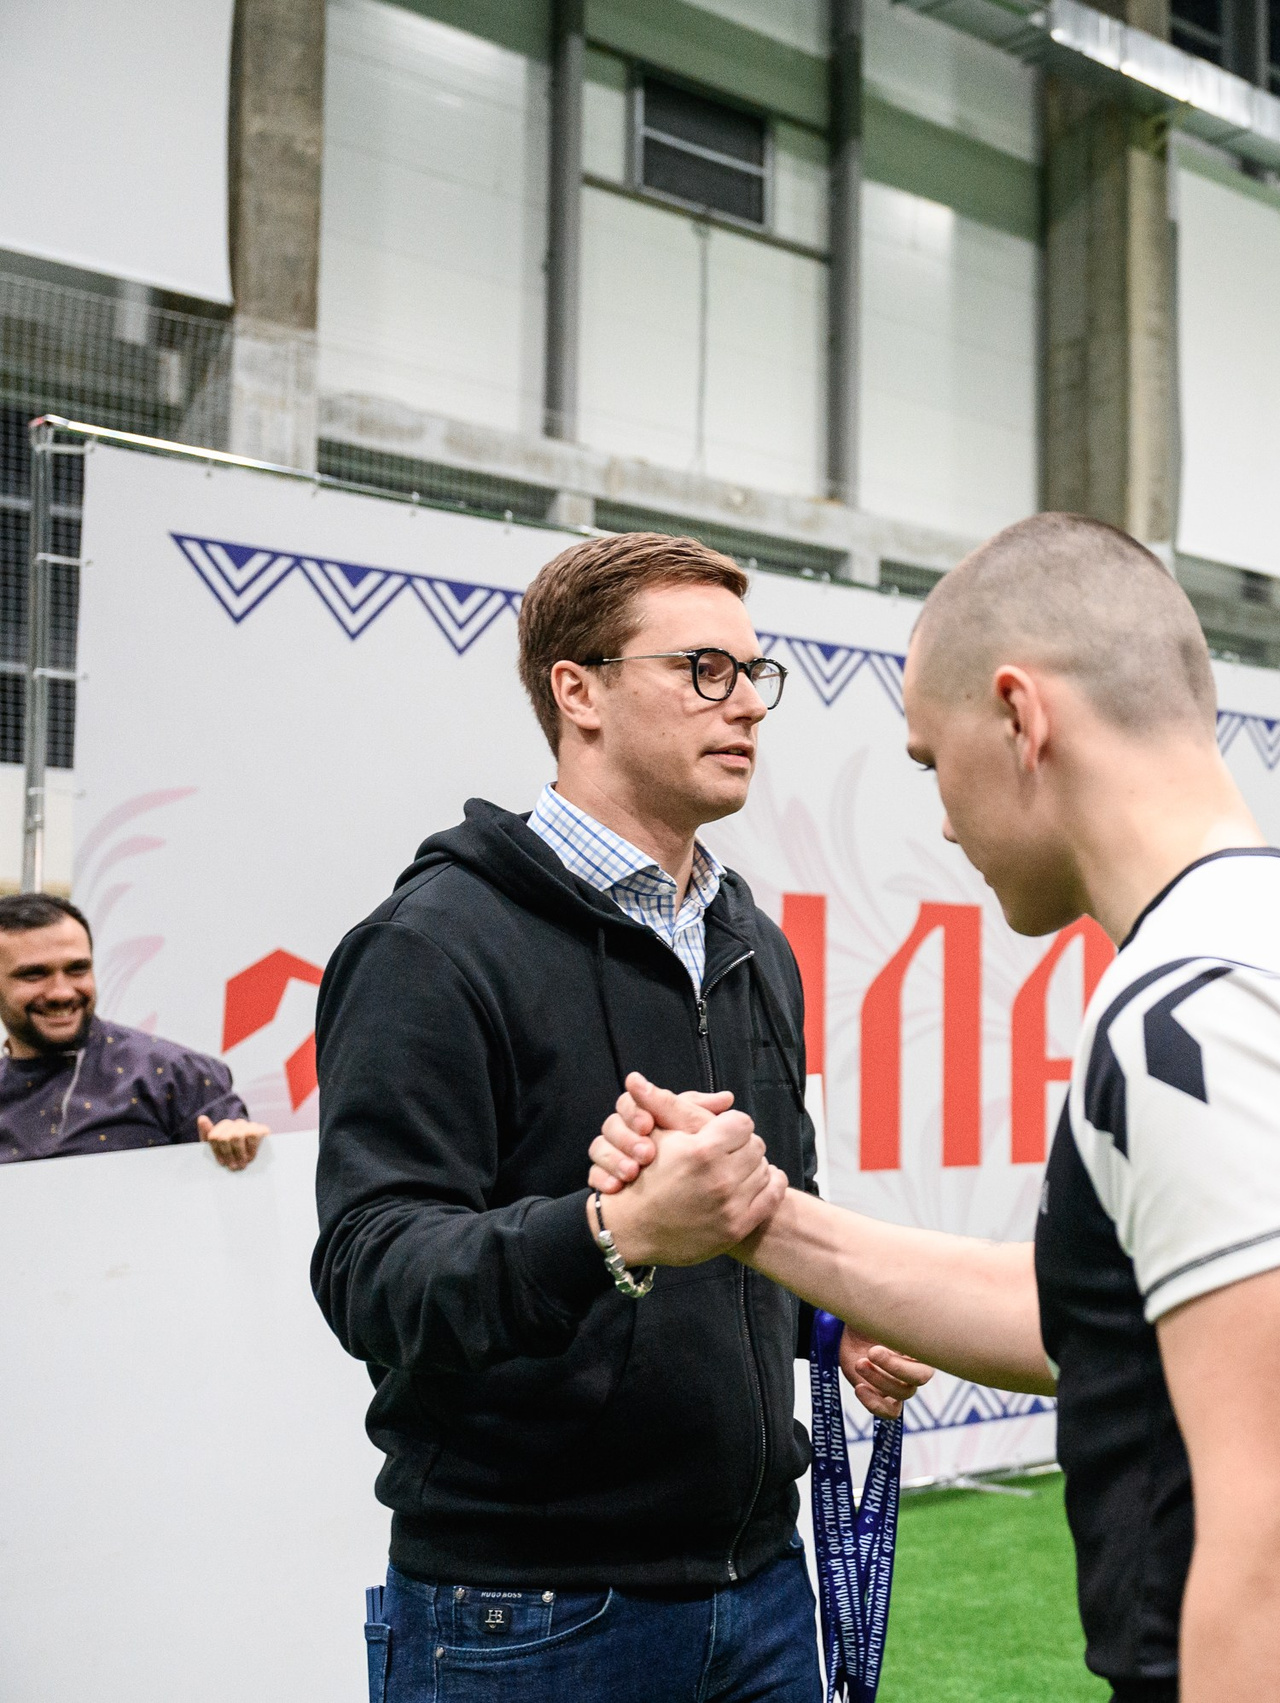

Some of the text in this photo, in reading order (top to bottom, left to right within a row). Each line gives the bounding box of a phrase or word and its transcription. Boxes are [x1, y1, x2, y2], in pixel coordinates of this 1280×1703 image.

[821, 1478, 842, 1555] ФЕСТИВАЛЬ
[836, 1481, 857, 1556] ФЕСТИВАЛЬ
[828, 1558, 857, 1676] МЕЖРЕГИОНАЛЬНЫЙ
[865, 1555, 891, 1688] МЕЖРЕГИОНАЛЬНЫЙ
[882, 1477, 898, 1553] ФЕСТИВАЛЬ
